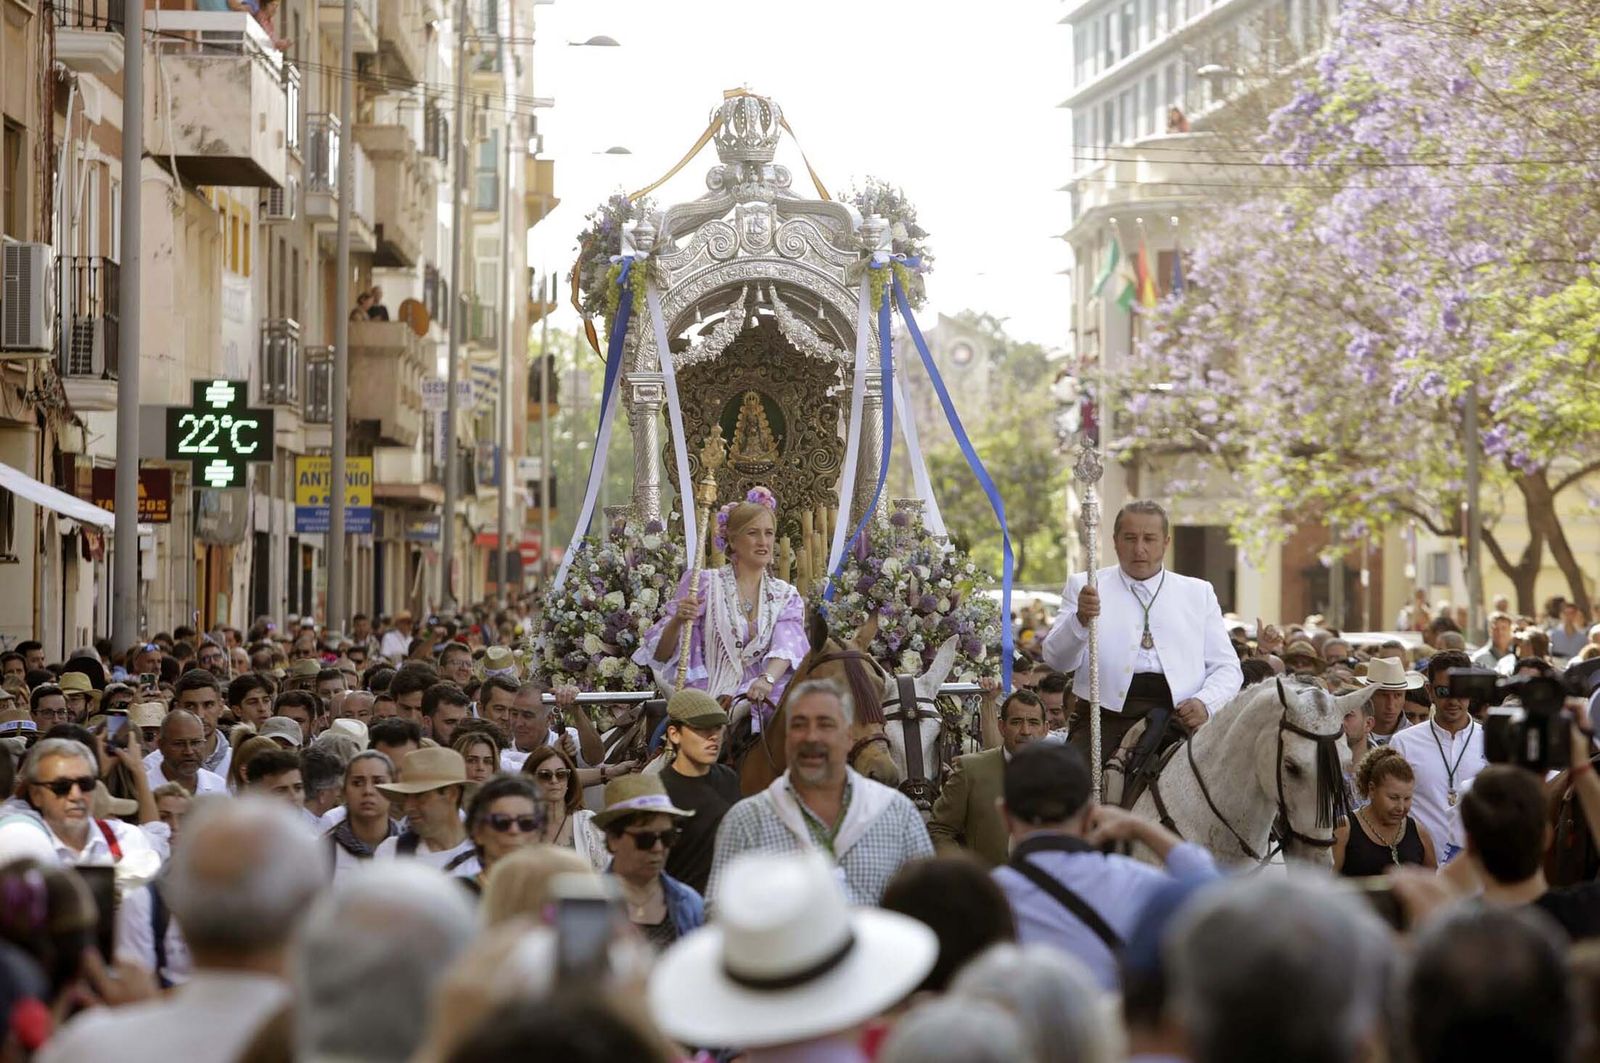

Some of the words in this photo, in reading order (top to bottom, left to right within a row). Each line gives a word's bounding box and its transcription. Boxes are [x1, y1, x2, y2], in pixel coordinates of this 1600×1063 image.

[178, 414, 258, 453] 22°C
[299, 471, 369, 486] ANTNIO
[95, 499, 167, 511] TACOS
